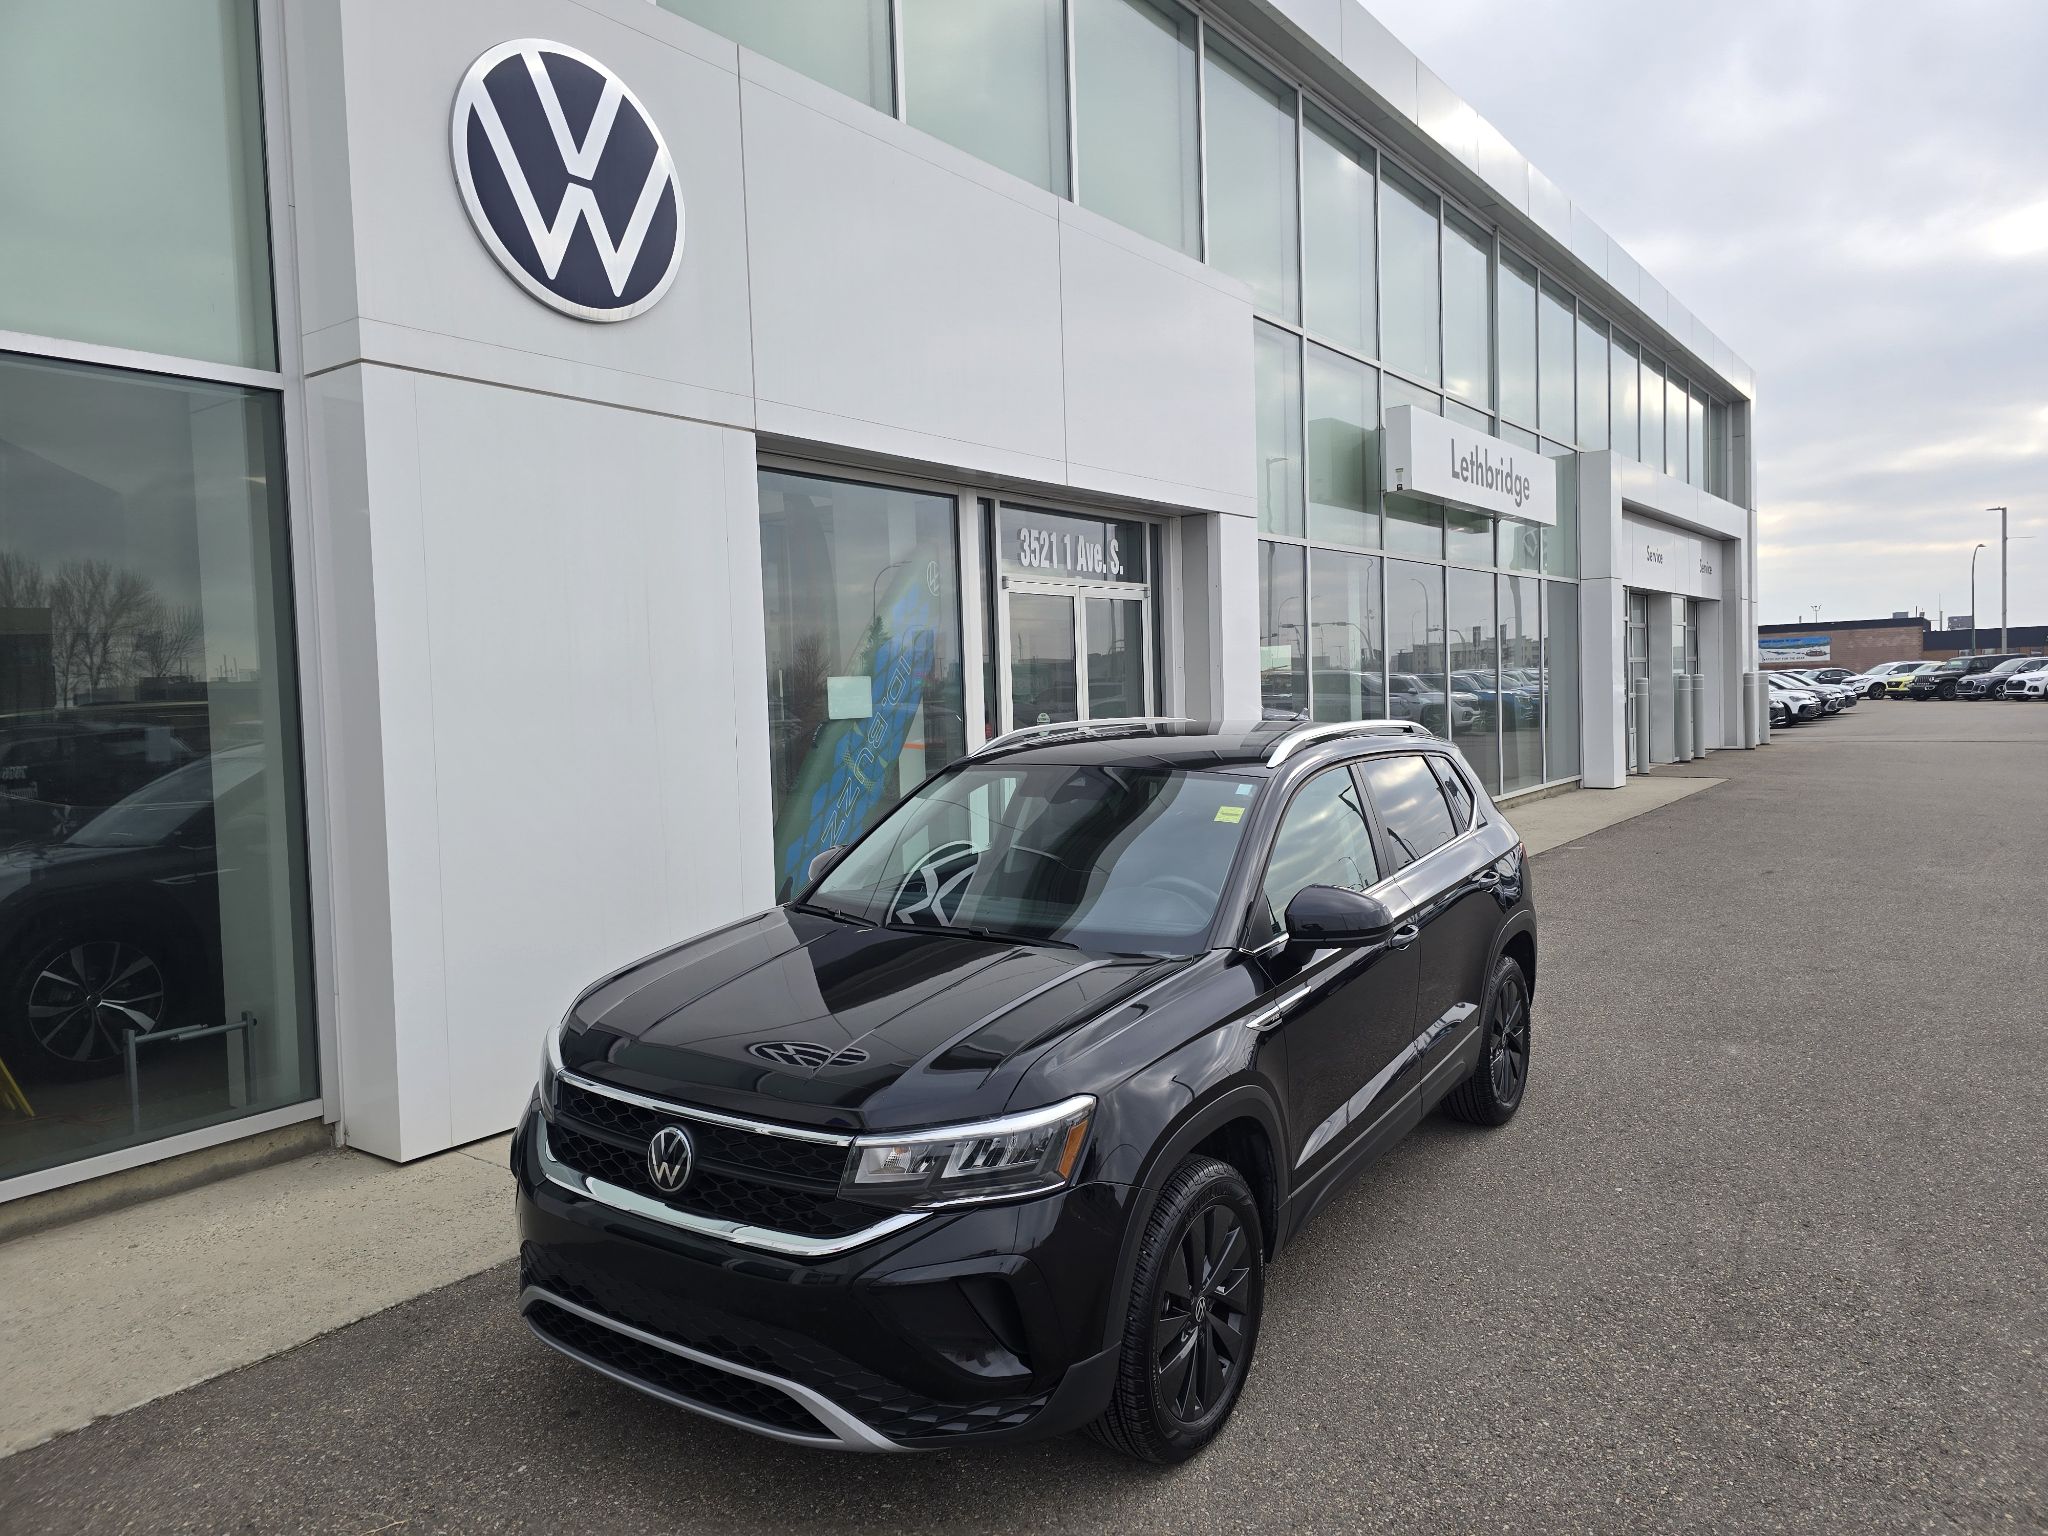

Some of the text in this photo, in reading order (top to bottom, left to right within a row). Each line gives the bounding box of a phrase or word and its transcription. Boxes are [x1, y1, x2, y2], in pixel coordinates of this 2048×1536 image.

[1451, 438, 1530, 508] Lethbridge
[1020, 527, 1124, 575] 3521 1 Ave. S.
[1646, 544, 1663, 565] Service
[1699, 558, 1713, 575] Service
